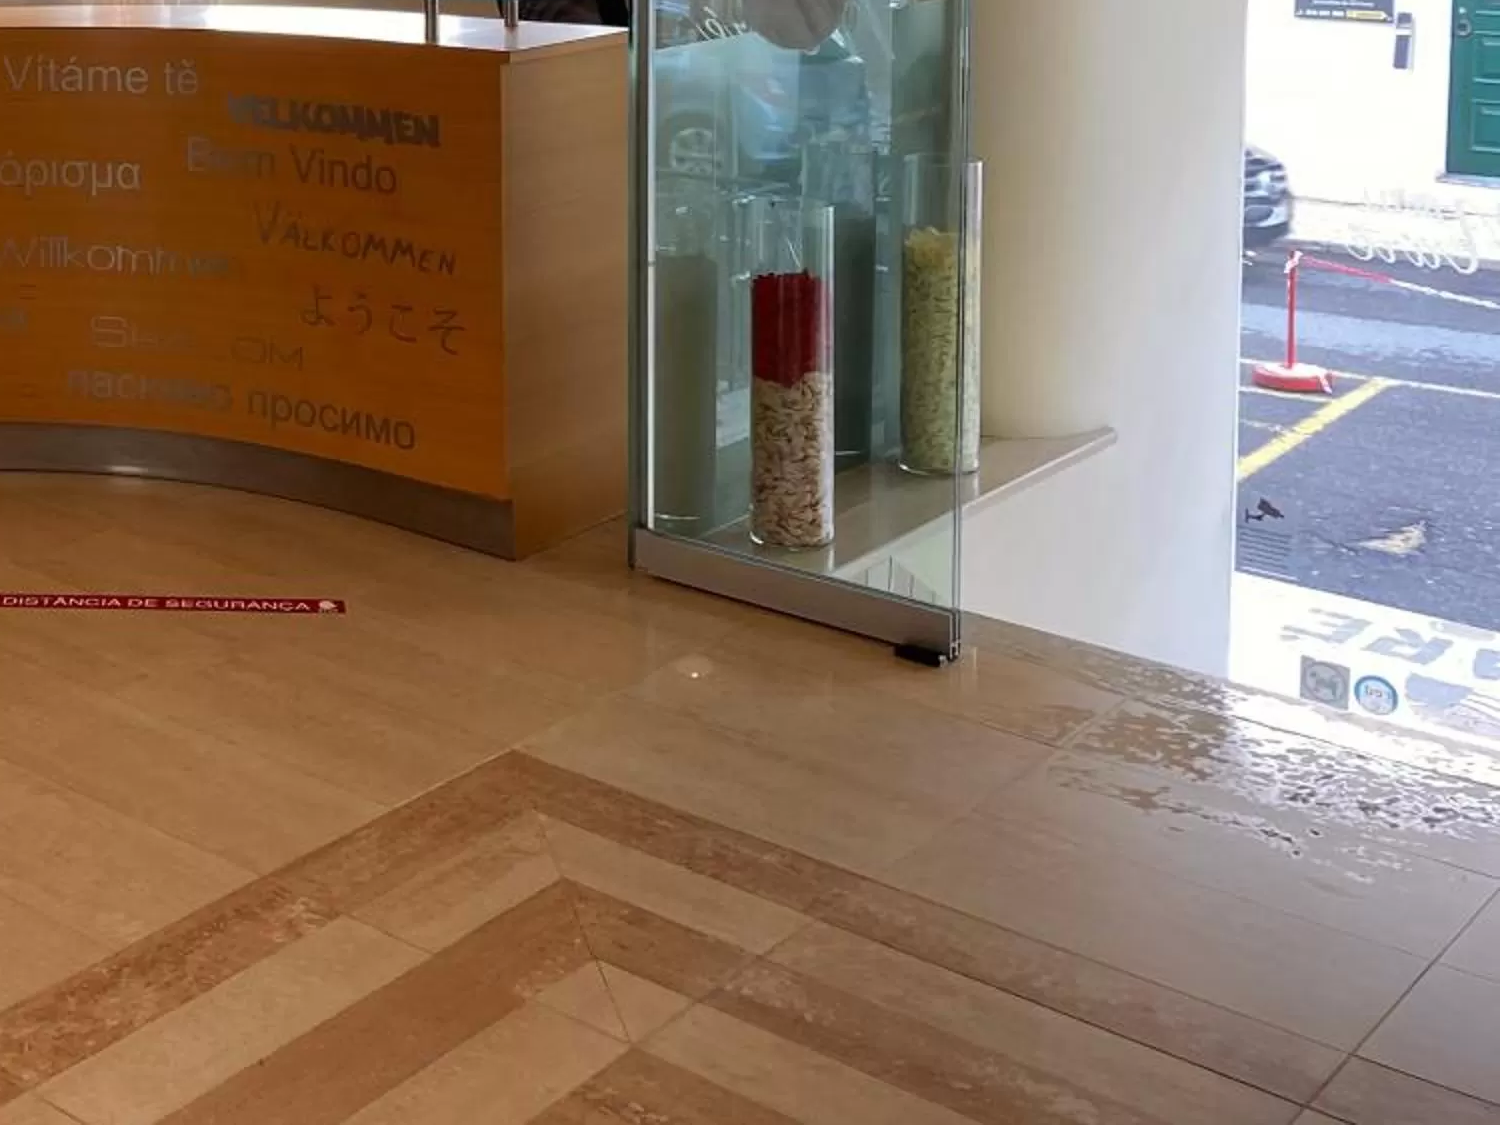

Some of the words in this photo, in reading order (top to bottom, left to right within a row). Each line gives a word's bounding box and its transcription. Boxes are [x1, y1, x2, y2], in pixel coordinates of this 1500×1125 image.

[2, 52, 150, 94] Vítáme
[165, 58, 200, 97] tě
[290, 143, 398, 196] Vindo
[302, 282, 468, 357] ようこそ
[247, 387, 418, 452] просимо
[127, 597, 158, 608] DE
[165, 598, 311, 612] SEGURANÇA
